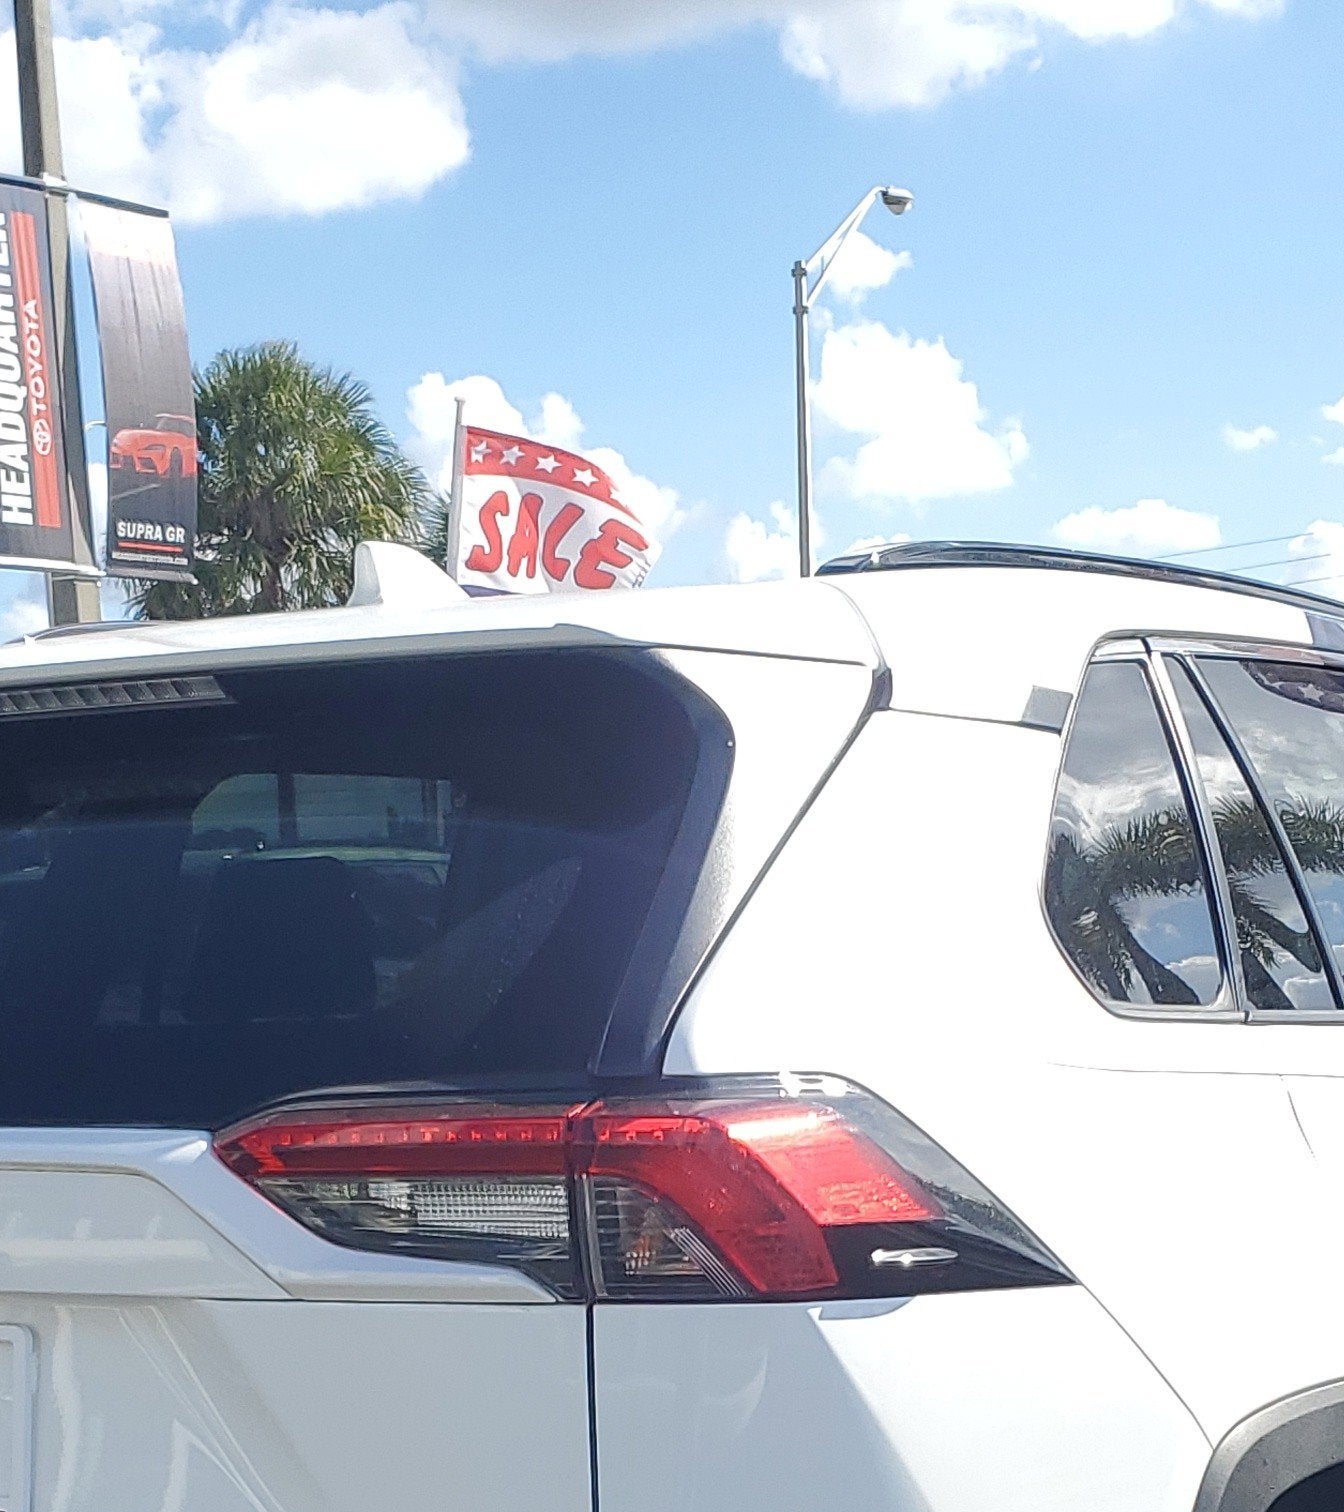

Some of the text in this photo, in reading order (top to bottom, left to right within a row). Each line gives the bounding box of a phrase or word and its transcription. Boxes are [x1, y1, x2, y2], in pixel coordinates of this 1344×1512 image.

[22, 299, 47, 416] TOYOTA
[117, 520, 186, 543] SUPRA GR
[465, 490, 649, 590] SALE
